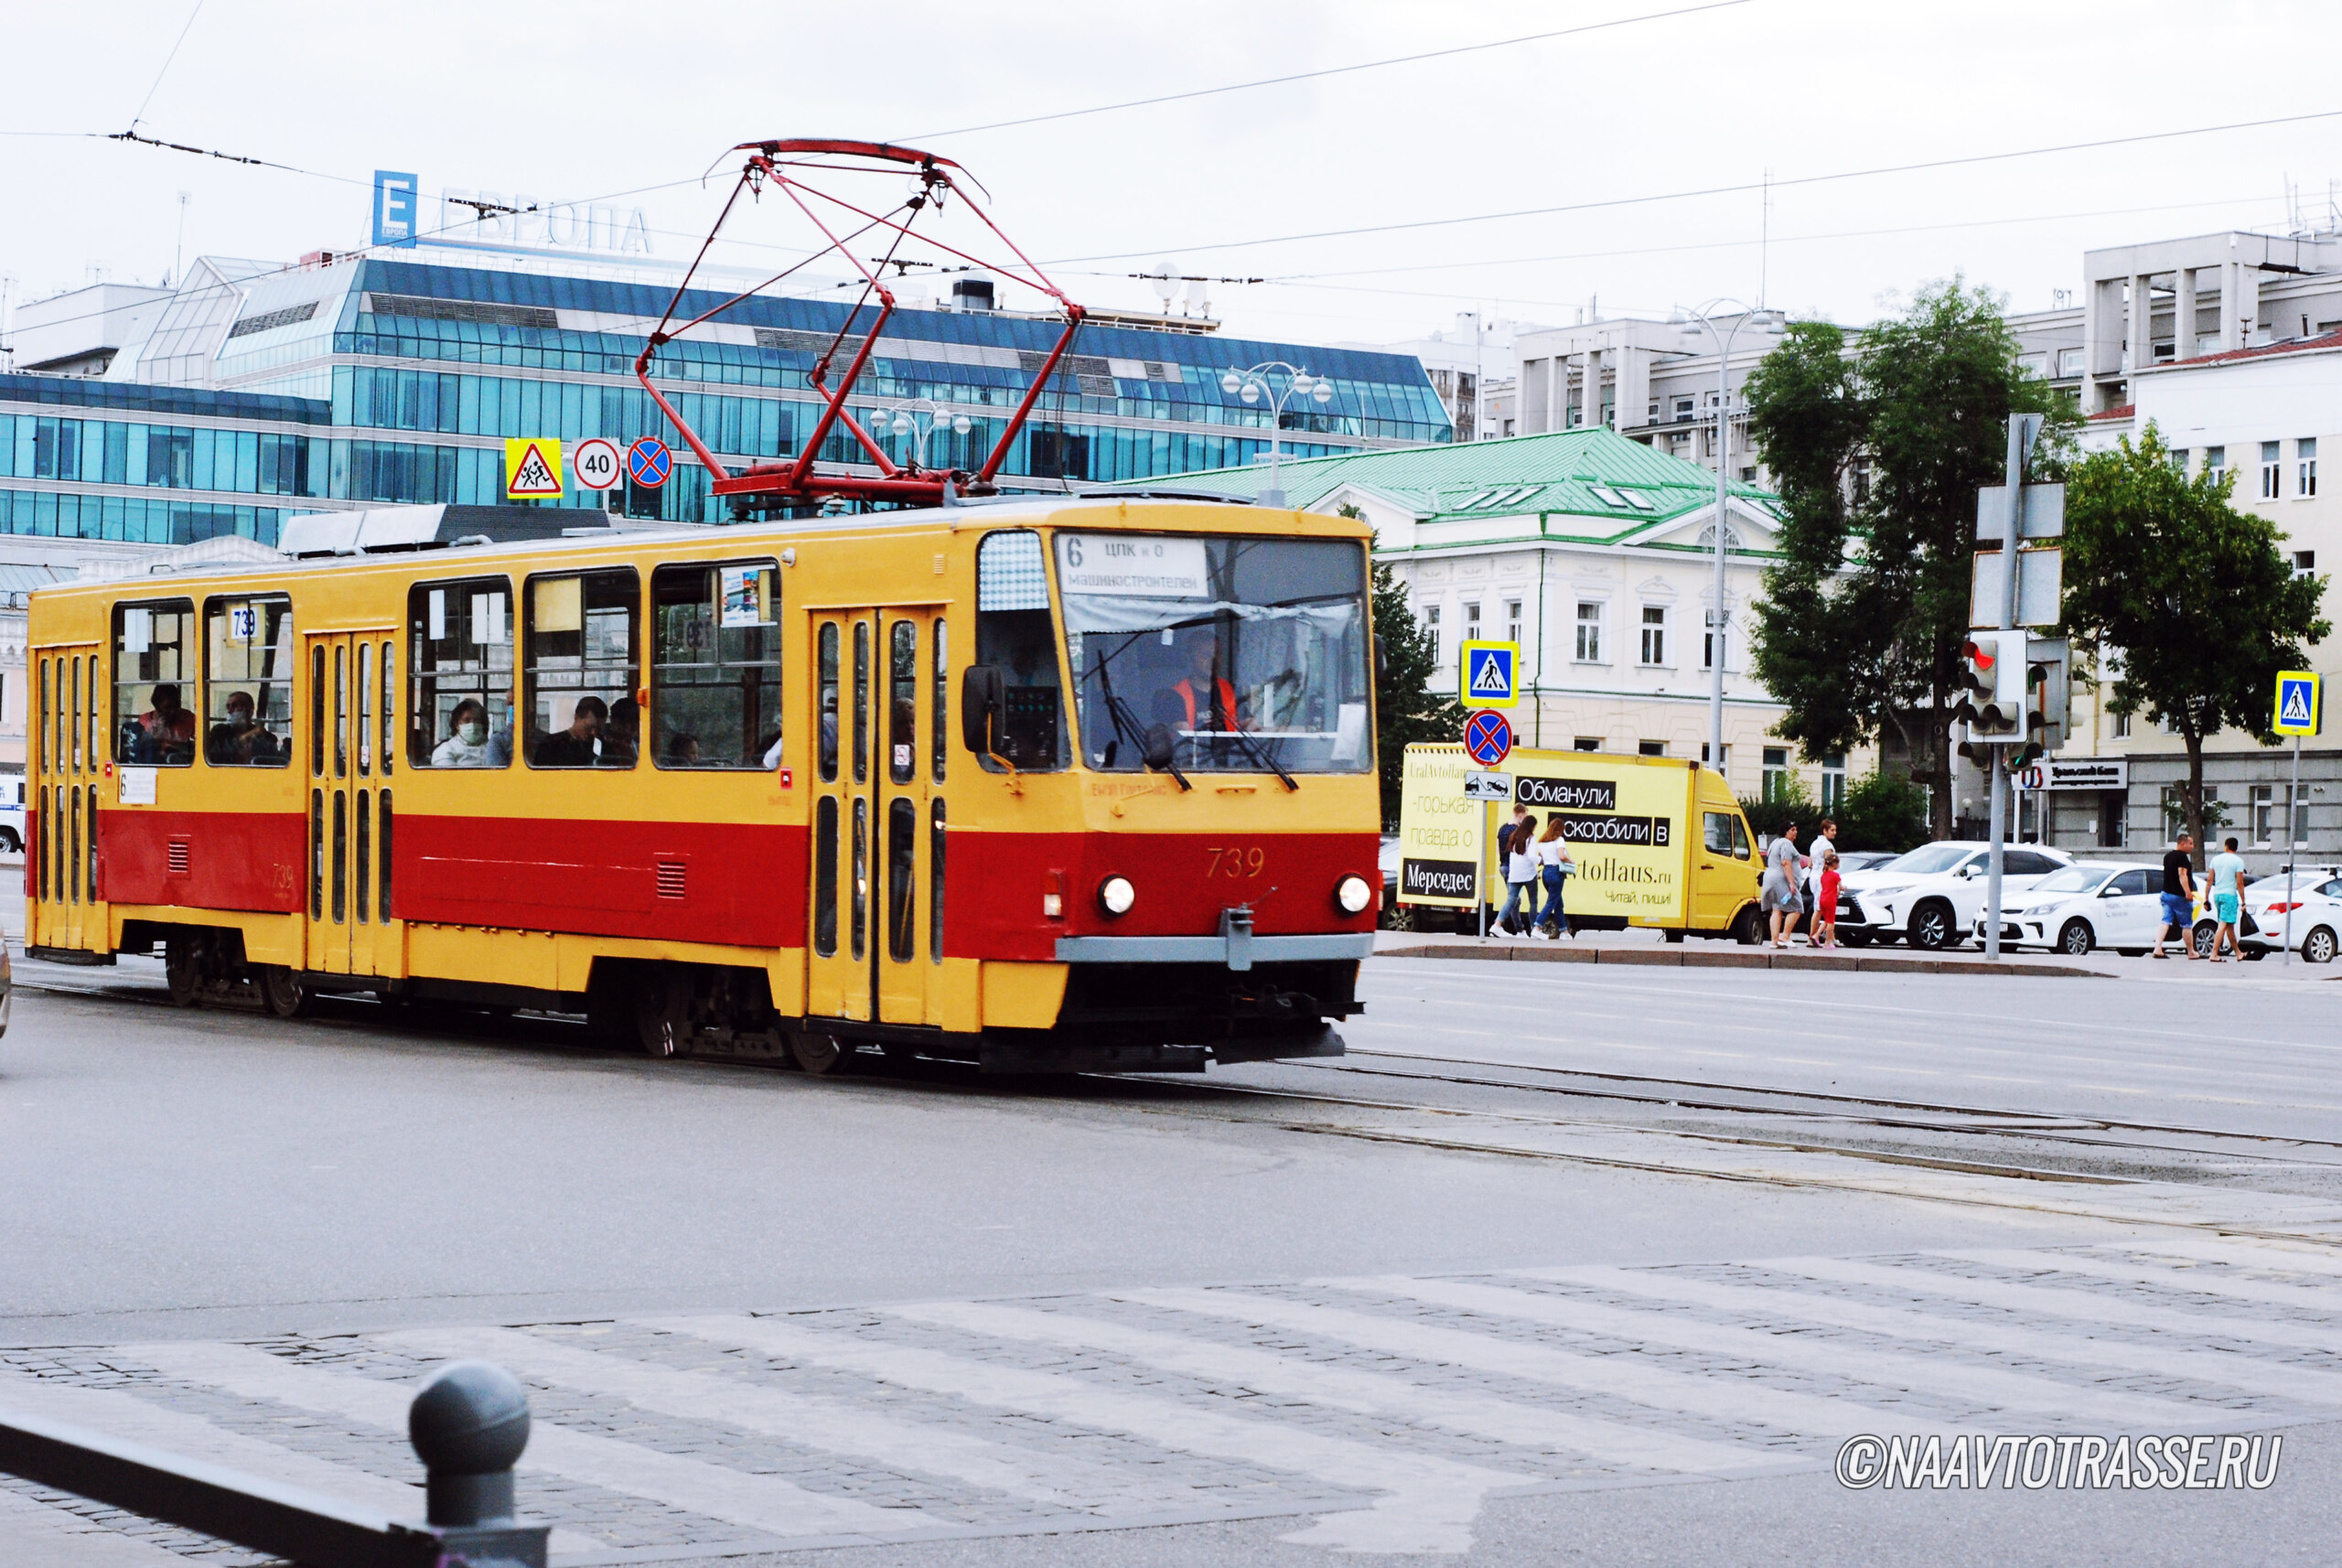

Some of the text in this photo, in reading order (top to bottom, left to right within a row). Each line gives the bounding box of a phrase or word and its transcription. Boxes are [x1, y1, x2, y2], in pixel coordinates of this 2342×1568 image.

[382, 179, 410, 229] Е
[381, 227, 409, 238] ЕВРОПА
[442, 188, 654, 254] ЕВРОПА
[586, 455, 609, 474] 40
[1067, 537, 1083, 568] 6
[1105, 542, 1136, 559] ЦПК
[1154, 544, 1164, 558] О
[233, 609, 255, 637] 739
[1410, 763, 1471, 779] UralAvtoHau
[120, 773, 126, 797] 6
[1518, 779, 1615, 809] Обманули,
[1411, 826, 1474, 851] правда о
[1563, 817, 1668, 843] скорбили в
[274, 863, 295, 888] 739
[1207, 847, 1264, 878] 739
[1566, 857, 1672, 885] vtoHaus.ru
[1407, 864, 1473, 895] Мерседес
[1605, 890, 1638, 905] Читай,
